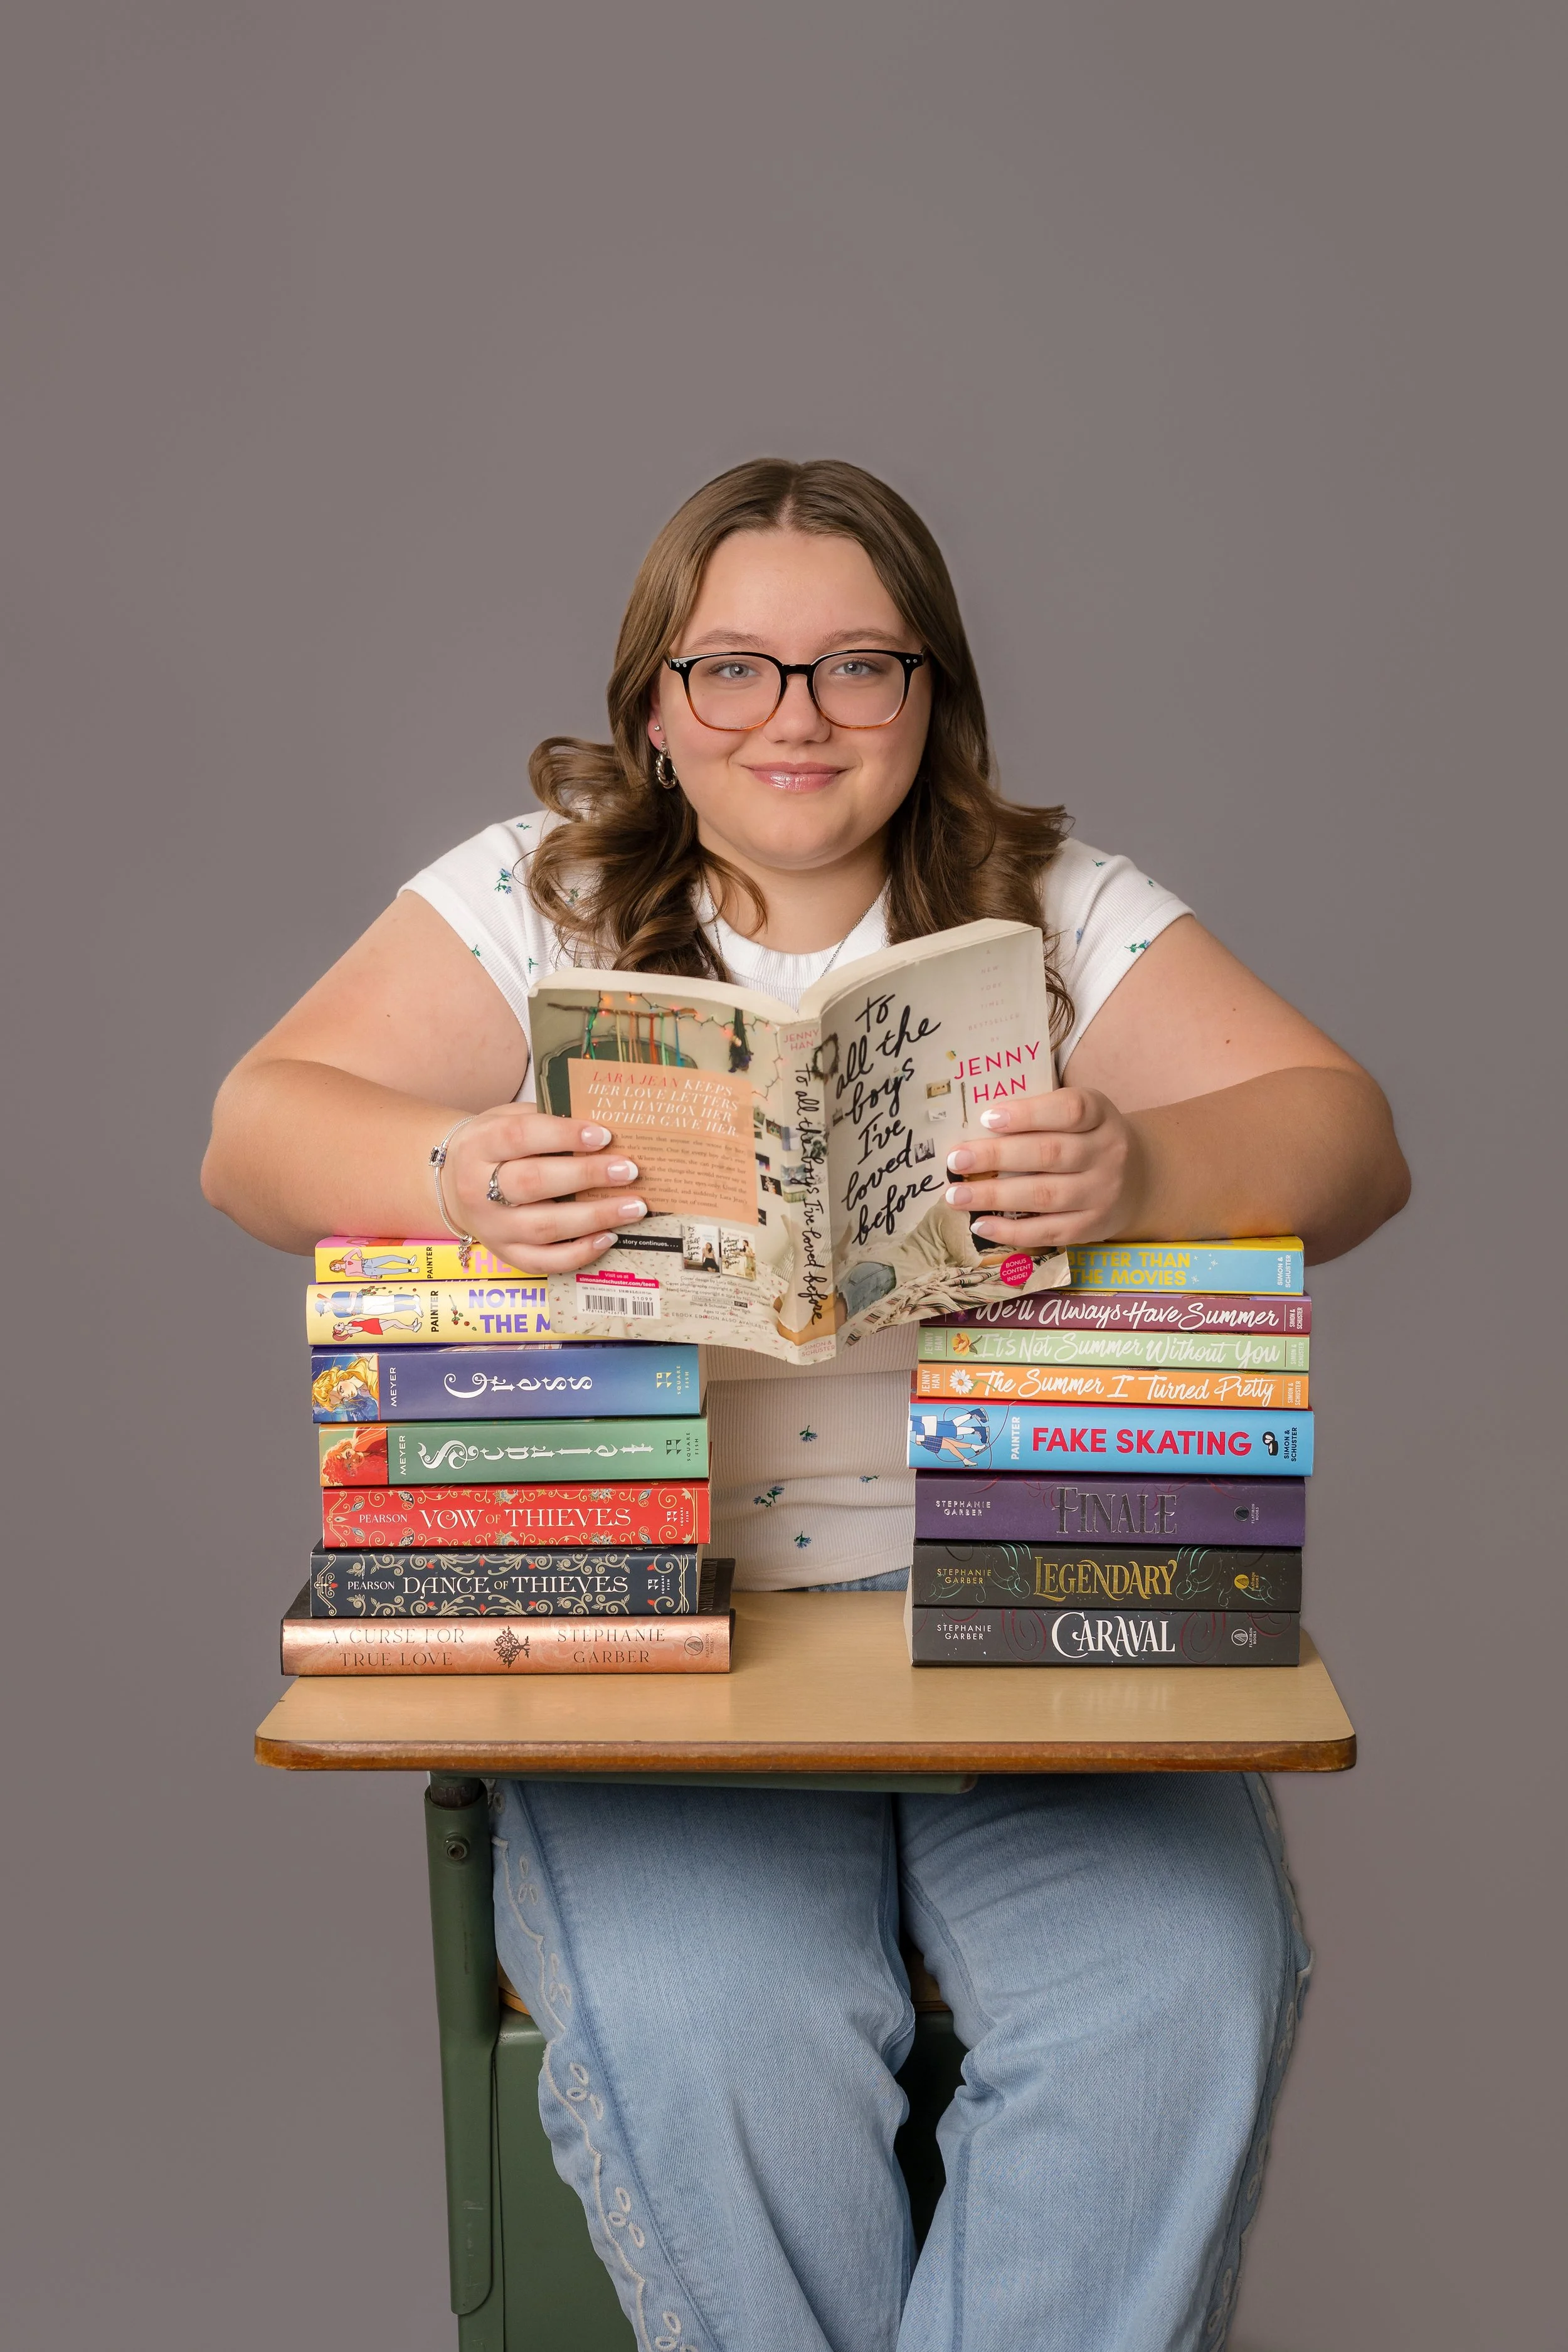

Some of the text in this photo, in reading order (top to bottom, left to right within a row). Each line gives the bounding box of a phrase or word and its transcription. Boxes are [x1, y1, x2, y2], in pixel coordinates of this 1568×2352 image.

[855, 993, 896, 1033] to
[968, 1011, 1020, 1031] BESTSELLER
[783, 1028, 820, 1043] JENNY
[790, 1040, 814, 1051] HAN
[835, 1005, 941, 1100] all the
[953, 1041, 1040, 1080] JENNY
[593, 1071, 733, 1096] LARA JEAN KEEPS
[844, 1057, 915, 1125] boys
[973, 1074, 1027, 1104] HAN
[588, 1084, 739, 1111] HER LOVE LETTERS
[596, 1097, 732, 1123] IN A HATBOX HER
[795, 1091, 820, 1116] all
[590, 1110, 739, 1138] MOTHER GAVE HER.
[795, 1117, 822, 1156] the
[857, 1111, 906, 1165] I've
[790, 1156, 825, 1194] boys
[840, 1128, 913, 1211] loved
[803, 1199, 824, 1226] I've
[851, 1174, 945, 1246] before
[622, 1238, 637, 1246] story
[802, 1226, 825, 1268] loved
[1002, 1263, 1031, 1276] CONTENT
[1005, 1258, 1027, 1268] BONUS
[1068, 1251, 1190, 1268] BETTER THAN
[580, 1277, 655, 1287] simonandschuster.com/teen
[1007, 1271, 1028, 1282] INSIDE!
[1071, 1269, 1187, 1286] THE MOVIES
[430, 1290, 439, 1332] PAINTER
[797, 1271, 828, 1326] before
[480, 1314, 528, 1333] THE
[738, 1320, 768, 1330] AVAILABLE
[975, 1299, 1279, 1330] We'll Always Have Summer
[801, 1345, 835, 1357] SCHUSTER
[804, 1341, 826, 1350] SIMON
[925, 1332, 934, 1355] JENNY
[973, 1330, 1280, 1369] It's Not Summer Without You
[443, 1372, 593, 1399] Cress
[921, 1369, 931, 1393] JENNY
[931, 1373, 940, 1389] HAN
[975, 1369, 1278, 1407] The Summer I Turned Pretty
[1010, 1416, 1020, 1460] PAINTER
[1032, 1427, 1252, 1456] FAKE SKATING
[417, 1439, 654, 1470] Scarlet
[935, 1500, 991, 1508] STEPHANIE
[943, 1508, 983, 1517] GARBER
[1051, 1487, 1177, 1534] FINALE
[359, 1508, 631, 1529] PEARSON VOW OF THIEVES
[347, 1576, 628, 1599] PEARSON DANCE OF THIEVES
[945, 1576, 983, 1584] GARBER
[1034, 1556, 1177, 1602] LEGENDARY
[327, 1628, 465, 1643] A CURSE FOR
[558, 1628, 665, 1643] STEPHANIE
[937, 1624, 992, 1632] STEPHANIE
[1051, 1611, 1175, 1658] CARAVAL
[339, 1652, 453, 1666] TRUE LOVE
[573, 1650, 650, 1663] GARBER
